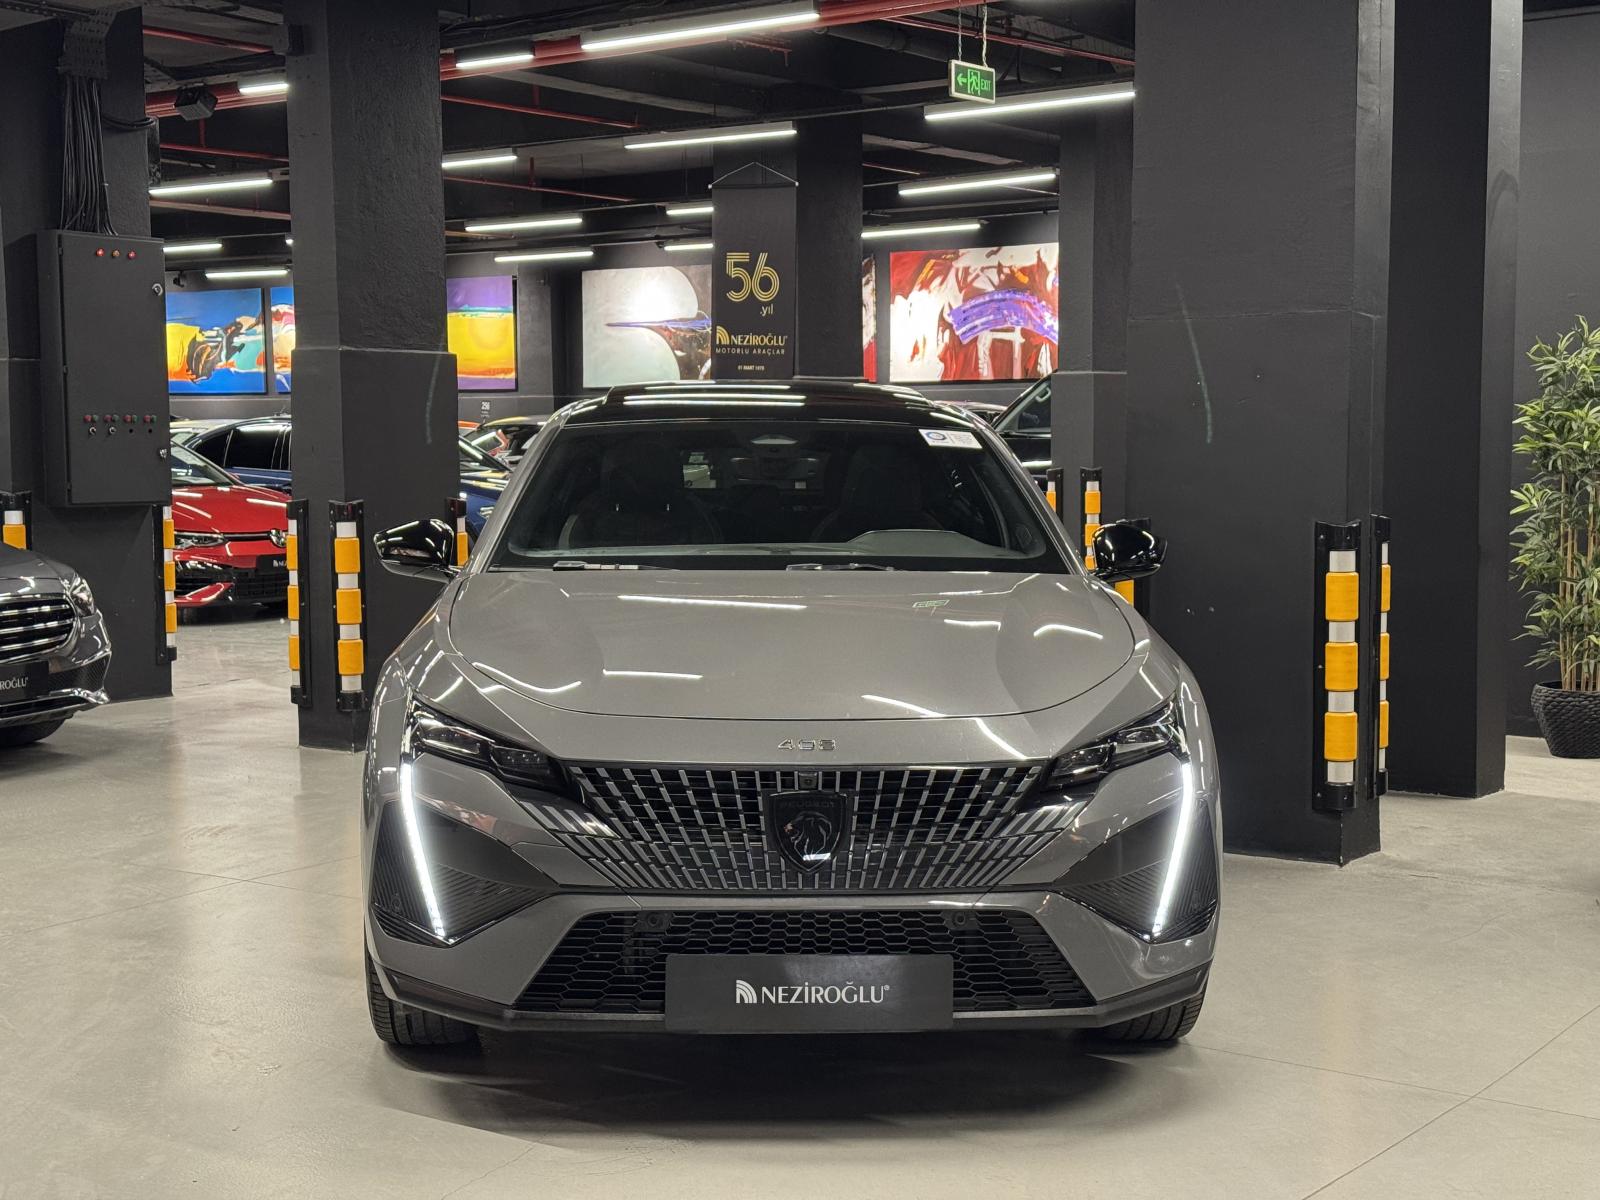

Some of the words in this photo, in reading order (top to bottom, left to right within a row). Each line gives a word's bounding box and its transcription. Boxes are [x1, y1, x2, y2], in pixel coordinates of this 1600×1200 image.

[981, 78, 992, 92] EXIT
[726, 252, 780, 302] 56
[715, 347, 750, 355] MOTORLU
[752, 348, 785, 356] ARAÇLAR
